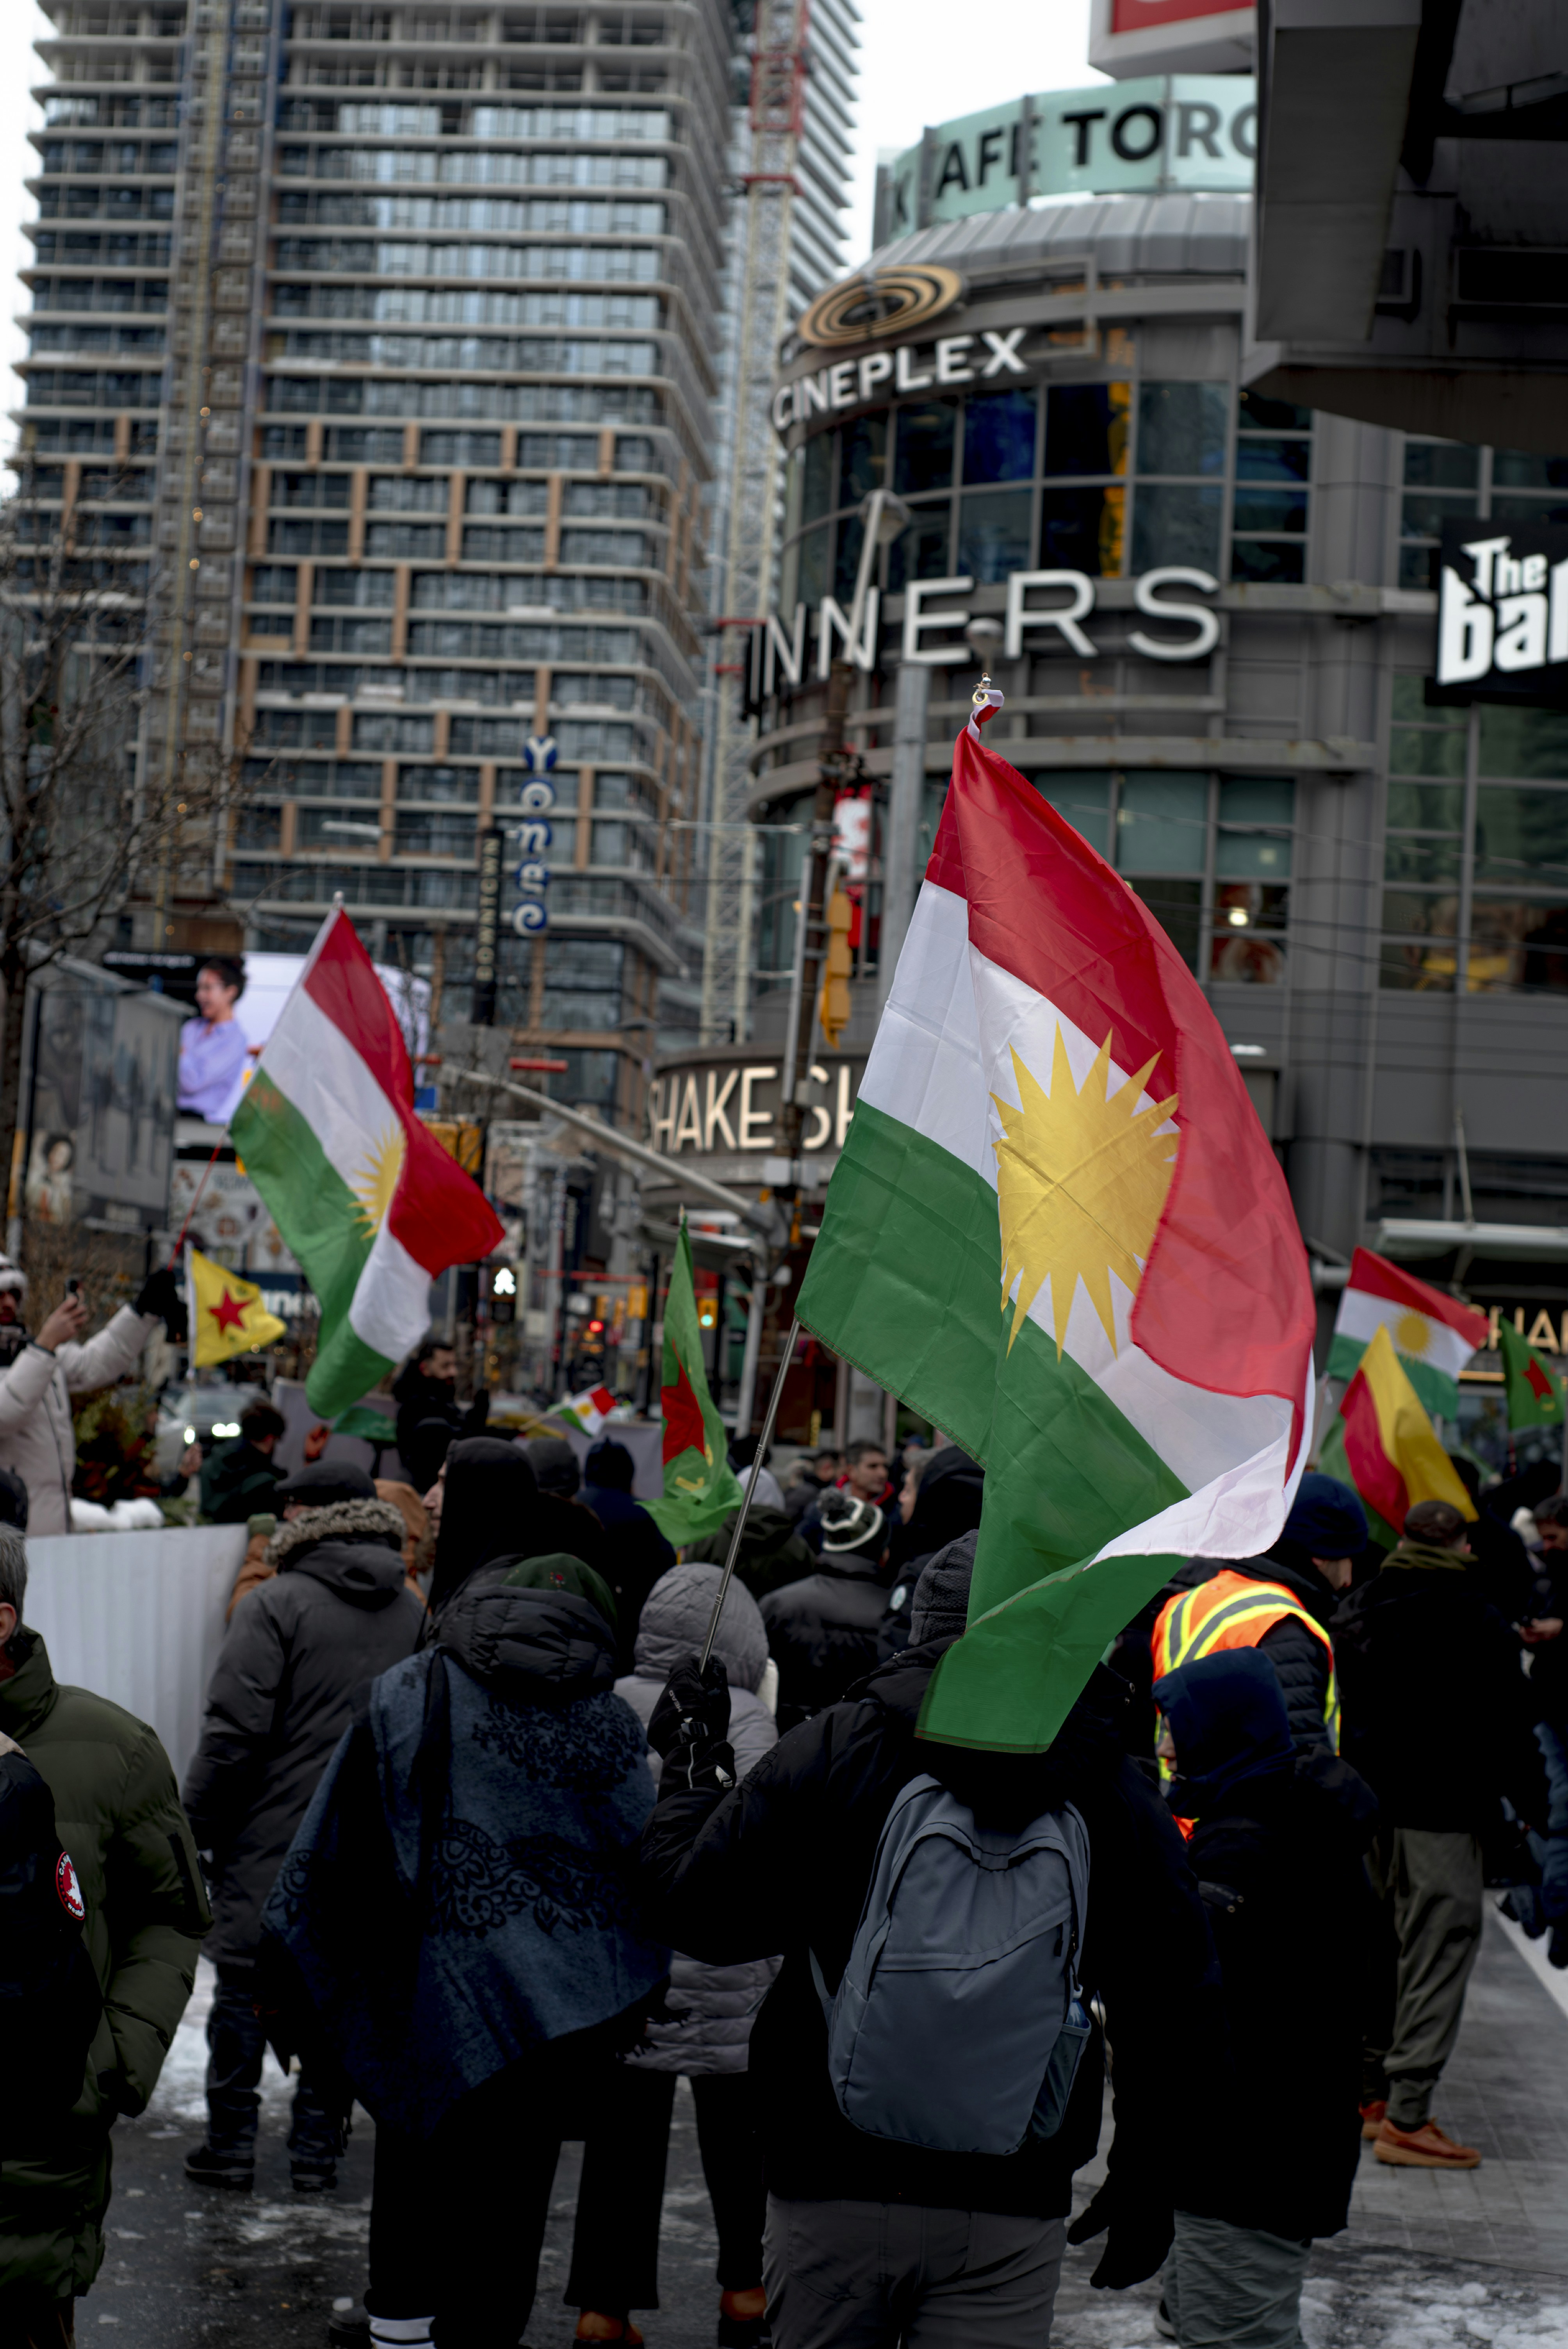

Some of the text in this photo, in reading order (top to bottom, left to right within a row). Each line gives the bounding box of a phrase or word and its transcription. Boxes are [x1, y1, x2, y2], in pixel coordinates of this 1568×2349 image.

[935, 119, 1042, 200] AFE
[772, 327, 1028, 430] CINEPLEX
[1461, 535, 1548, 602] The
[749, 566, 1221, 704] INNERS
[669, 1690, 682, 1713] HEAD
